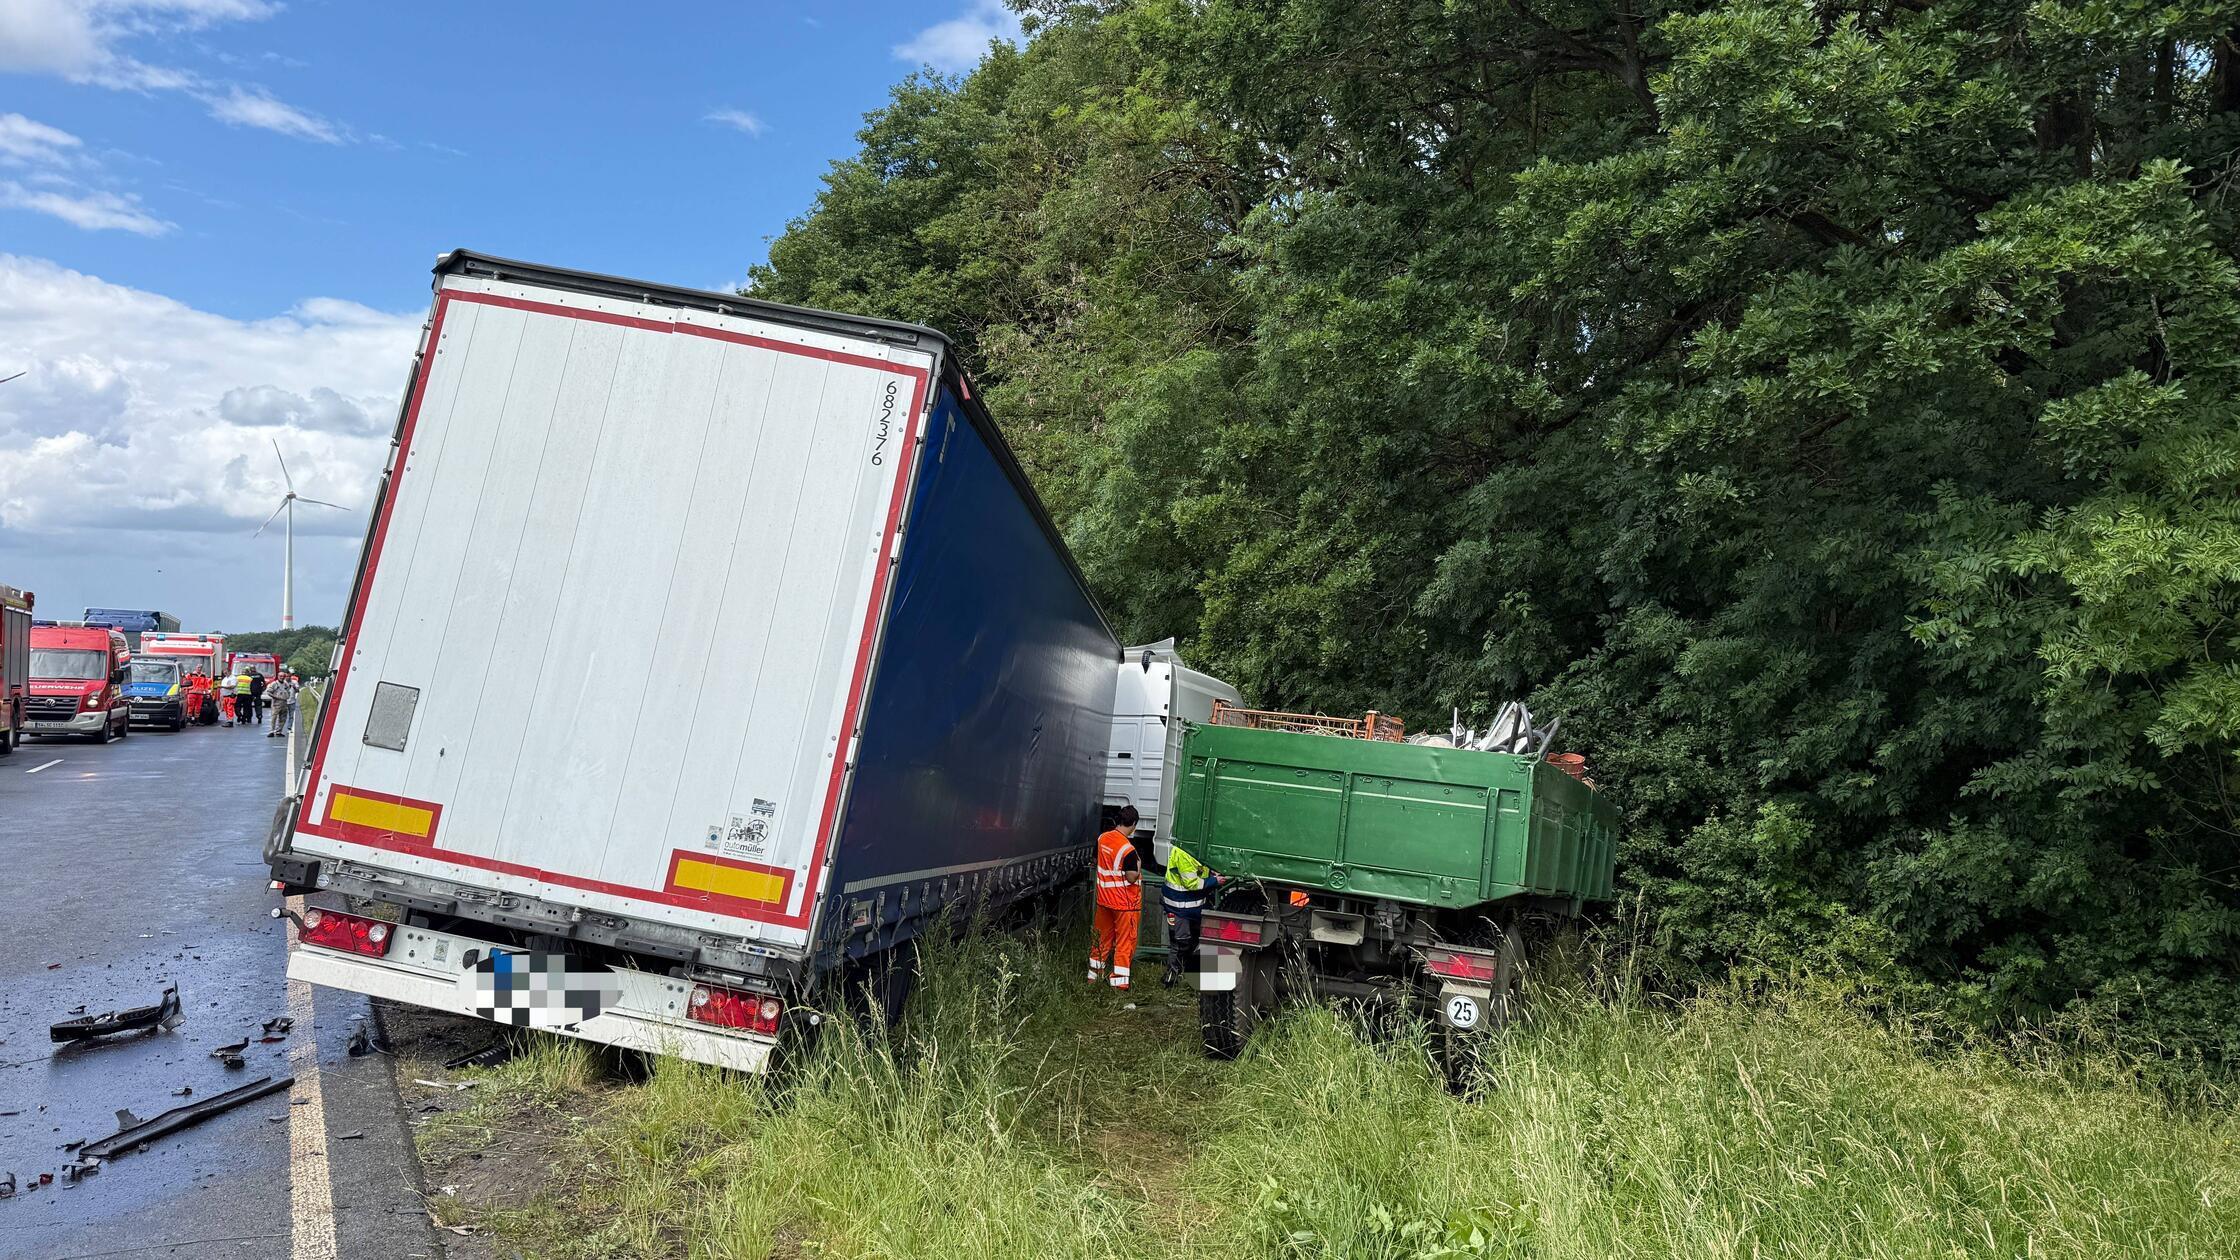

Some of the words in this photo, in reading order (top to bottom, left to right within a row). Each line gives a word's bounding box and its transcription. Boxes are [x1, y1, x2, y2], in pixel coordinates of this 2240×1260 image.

[871, 380, 897, 466] 682376
[724, 841, 765, 854] automüller
[1454, 1001, 1471, 1021] 25
